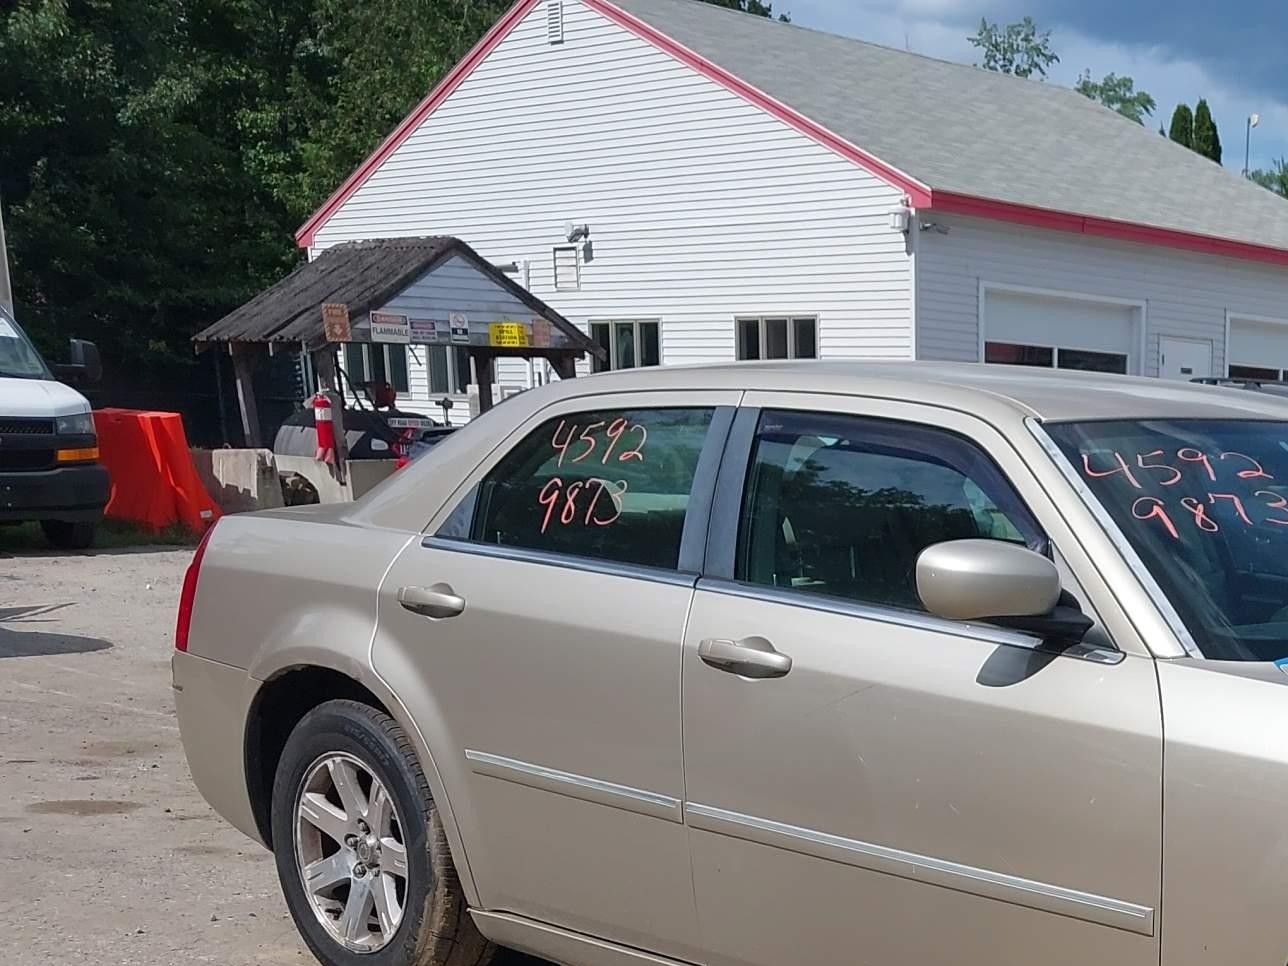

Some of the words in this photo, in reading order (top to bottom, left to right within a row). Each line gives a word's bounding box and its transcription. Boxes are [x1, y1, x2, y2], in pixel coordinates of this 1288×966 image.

[372, 326, 409, 337] FLAMMABLE
[551, 417, 648, 468] 4592
[1081, 447, 1274, 489] 4592
[538, 477, 629, 534] 9873
